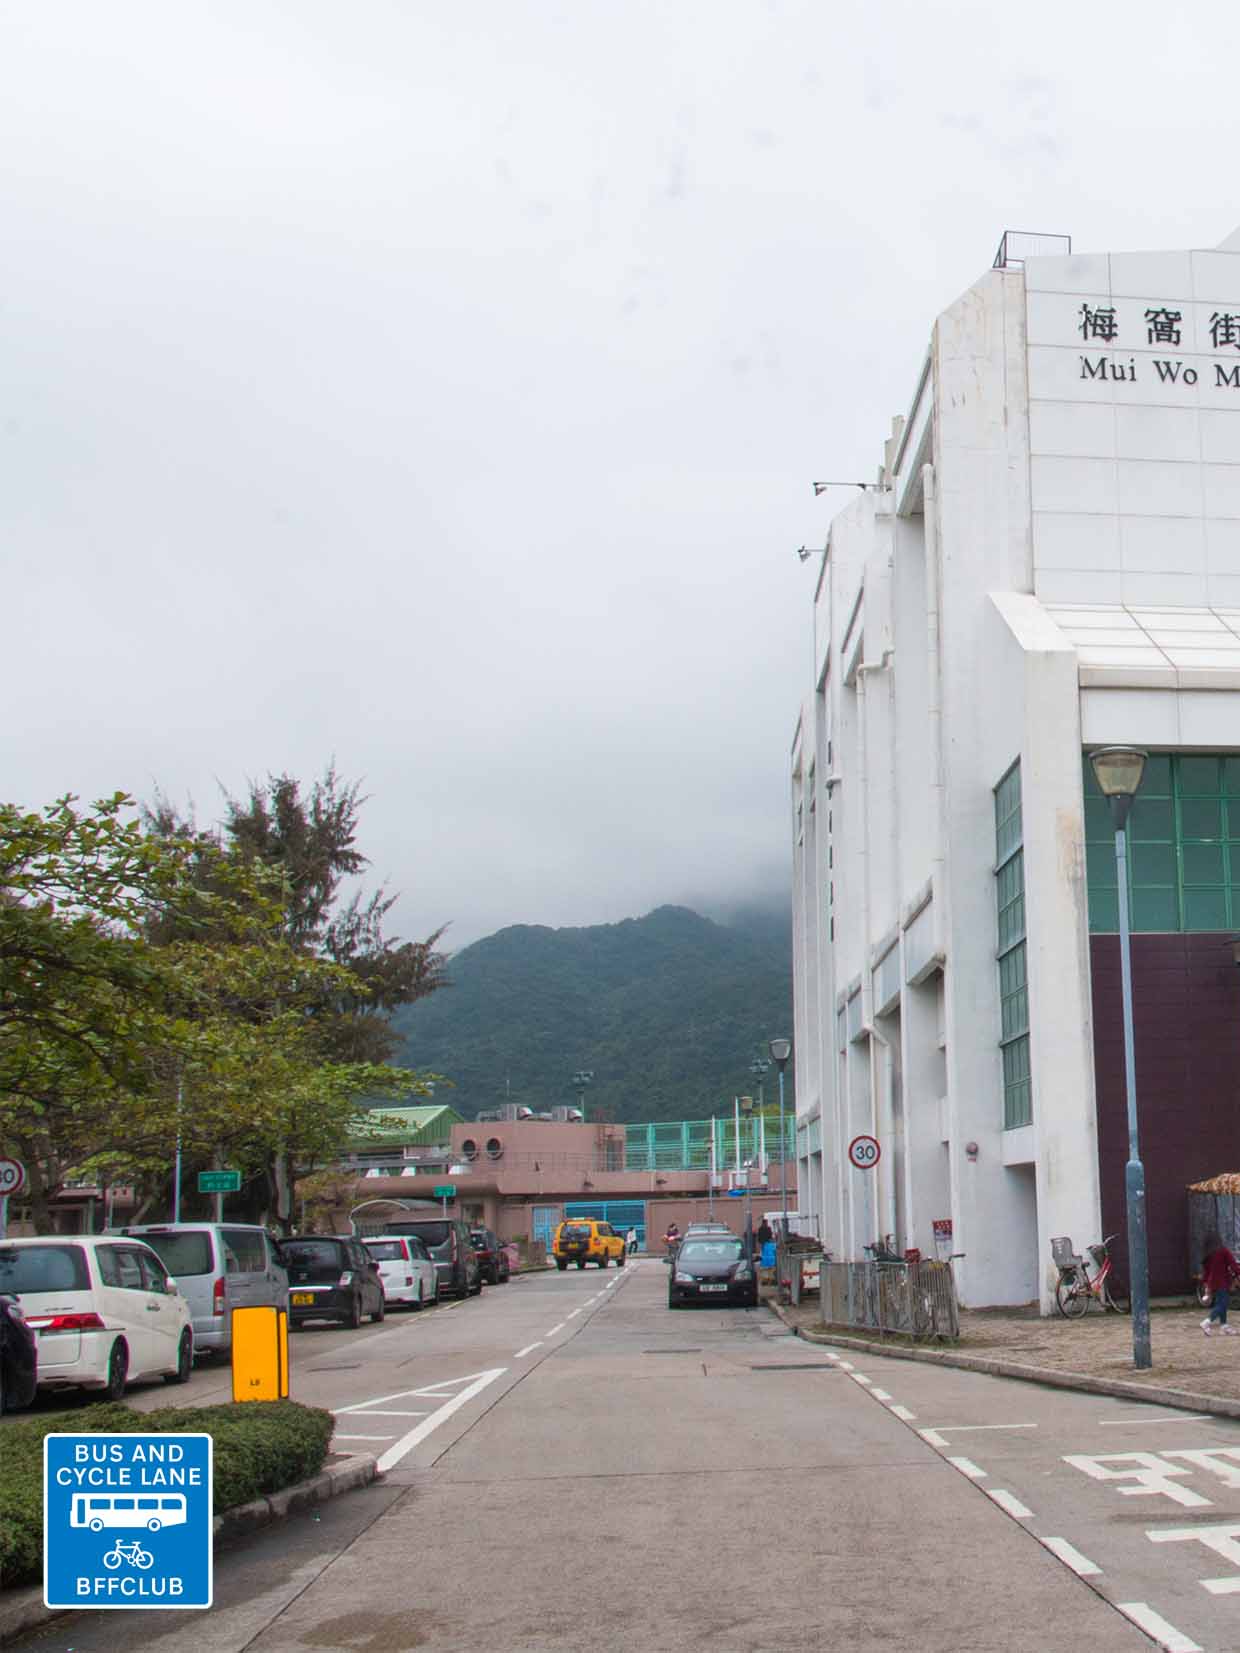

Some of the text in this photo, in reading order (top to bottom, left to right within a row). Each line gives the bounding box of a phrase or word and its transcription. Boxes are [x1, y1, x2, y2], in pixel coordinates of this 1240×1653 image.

[1079, 356, 1137, 382] Mui
[1152, 360, 1198, 385] Wo
[856, 1145, 876, 1161] 30
[0, 1168, 15, 1184] 0
